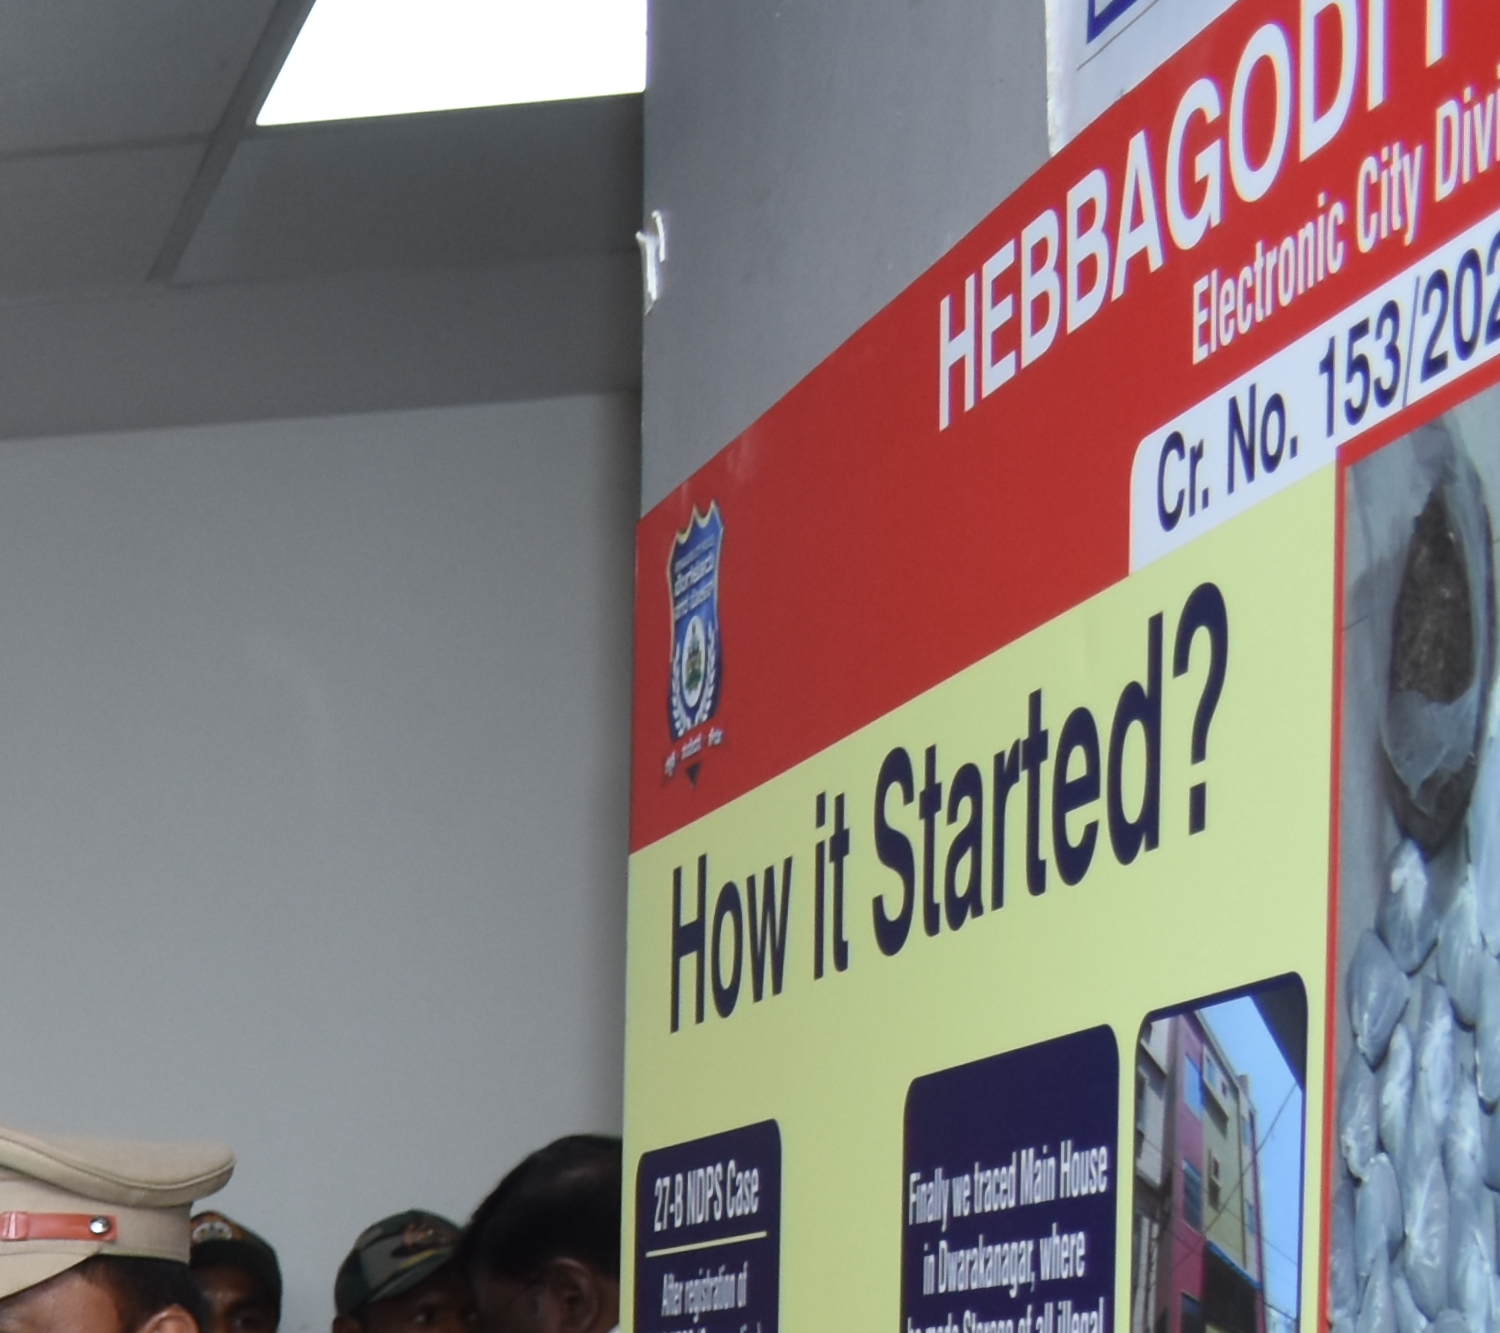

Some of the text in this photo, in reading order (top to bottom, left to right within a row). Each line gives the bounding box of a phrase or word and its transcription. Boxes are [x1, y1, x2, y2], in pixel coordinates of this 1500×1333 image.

[939, 0, 1386, 431] HEBBAGODI
[1192, 192, 1345, 366] Electronic
[1357, 141, 1422, 247] City
[1157, 430, 1209, 532] Cr.
[1226, 383, 1298, 496] No.
[670, 853, 794, 1034] How
[813, 791, 850, 981] it
[871, 581, 1229, 958] Started?
[654, 1160, 759, 1232] 27-B NDPS Case
[908, 1140, 1107, 1232] Finally we traced Main House
[661, 1261, 748, 1322] After registration of
[924, 1222, 1086, 1298] in Dwarakanagar, where
